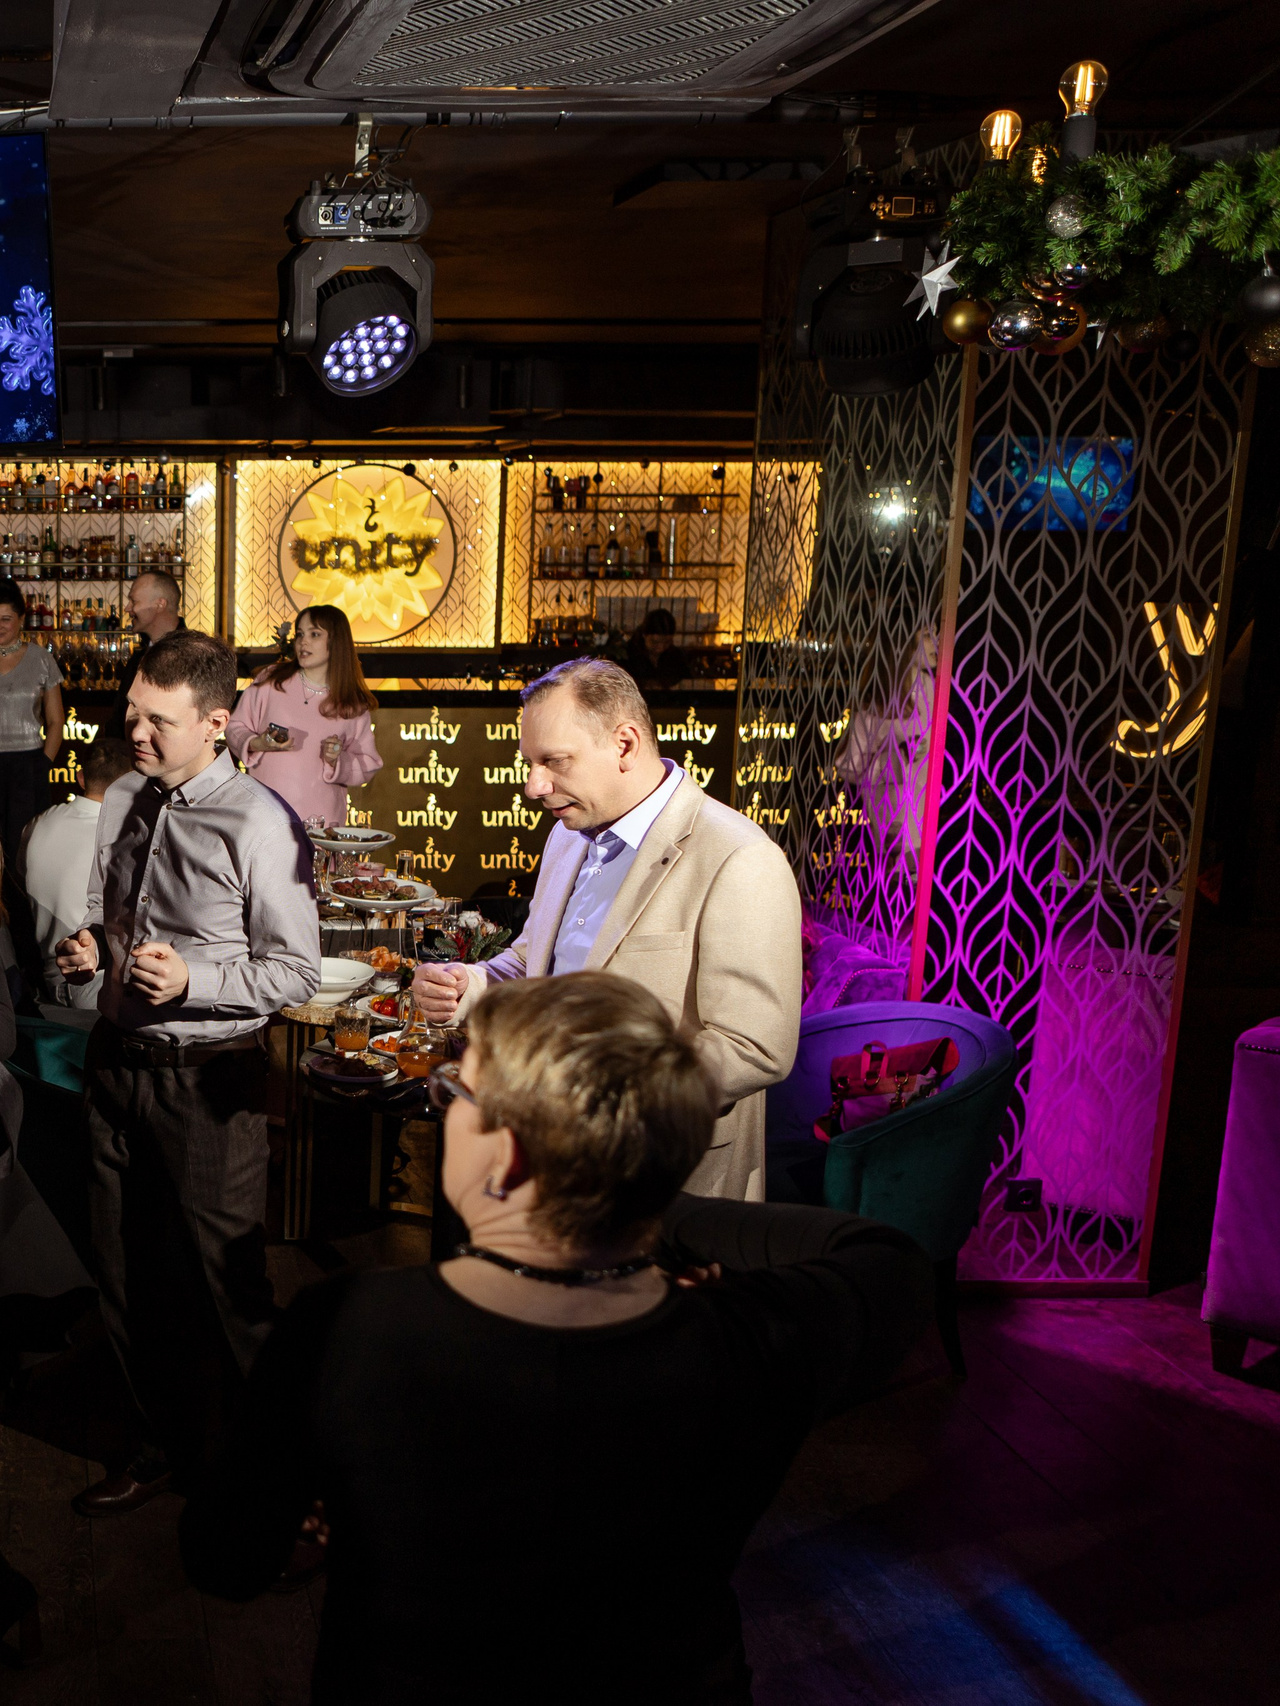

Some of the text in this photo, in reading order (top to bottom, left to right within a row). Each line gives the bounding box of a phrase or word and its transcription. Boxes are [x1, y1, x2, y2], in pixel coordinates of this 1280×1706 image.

[293, 497, 438, 578] unity
[399, 705, 461, 745] unity
[485, 706, 523, 740] uni
[656, 706, 718, 745] unity
[397, 749, 460, 788] unity
[483, 749, 531, 784] unit
[396, 792, 458, 831] unity
[481, 792, 543, 831] unity
[395, 836, 456, 873] nity
[480, 836, 541, 873] unity
